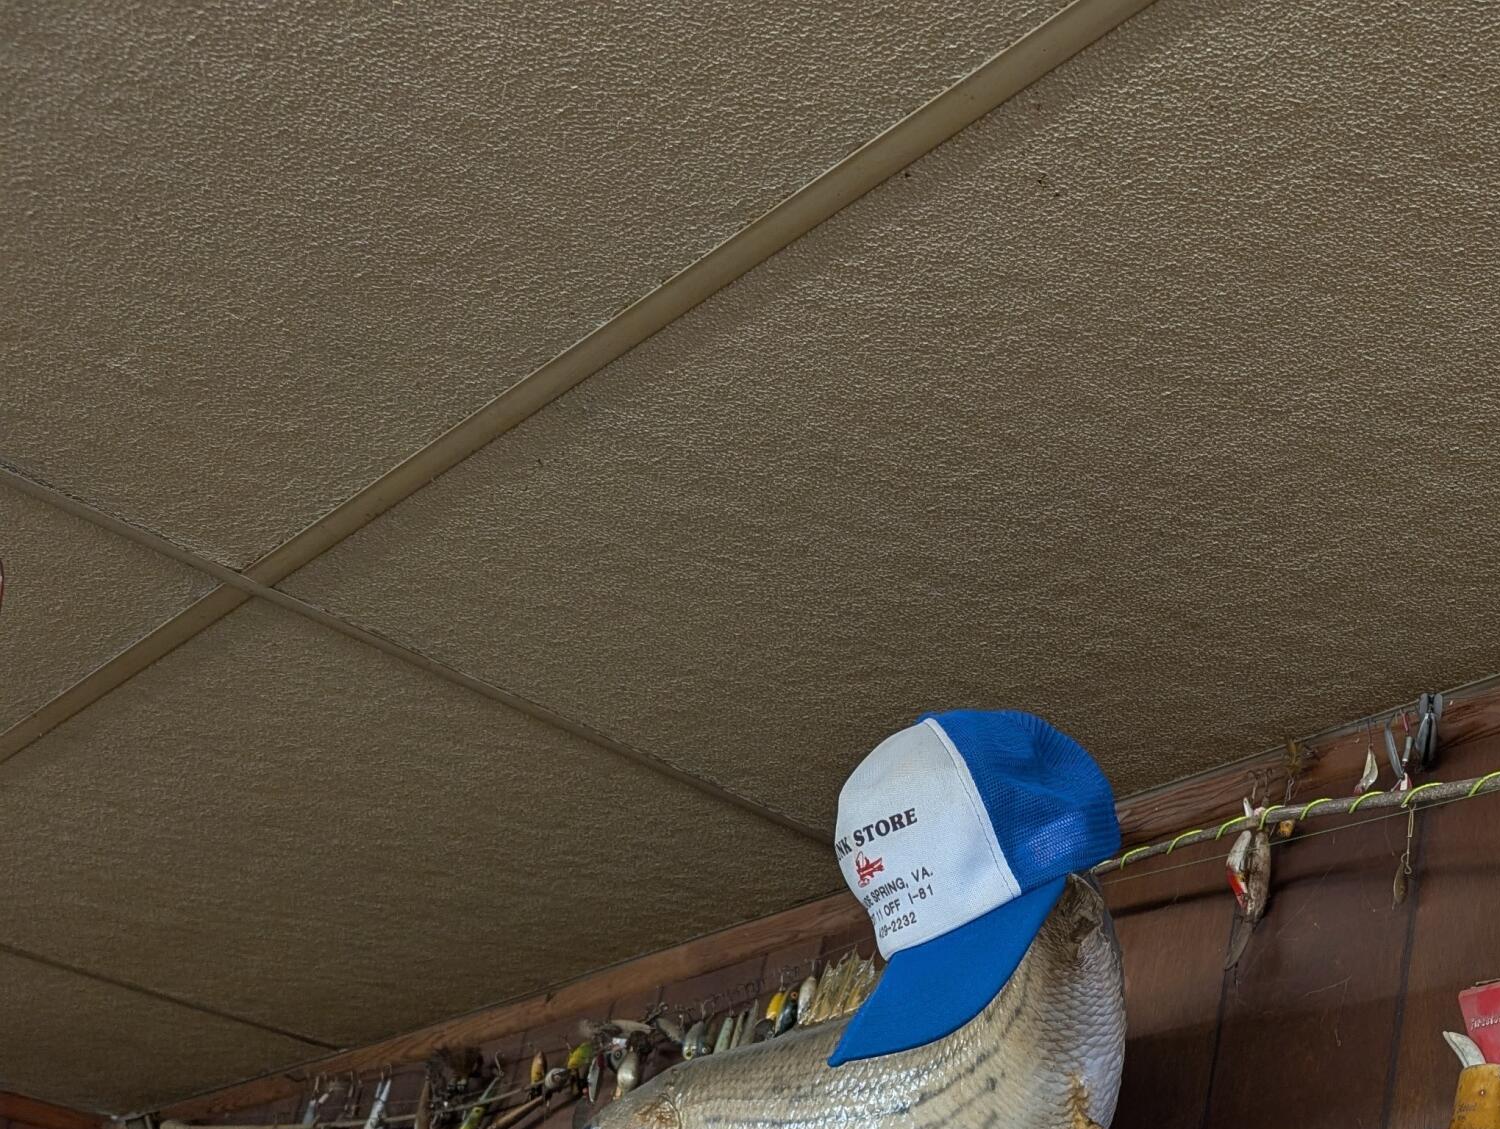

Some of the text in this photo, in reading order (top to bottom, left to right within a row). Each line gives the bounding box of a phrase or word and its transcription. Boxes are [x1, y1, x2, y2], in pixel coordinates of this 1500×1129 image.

[853, 808, 918, 847] STORE
[870, 877, 909, 903] SPRING,
[911, 866, 934, 883] VA.
[883, 899, 901, 917] OFF
[908, 884, 934, 905] I-81
